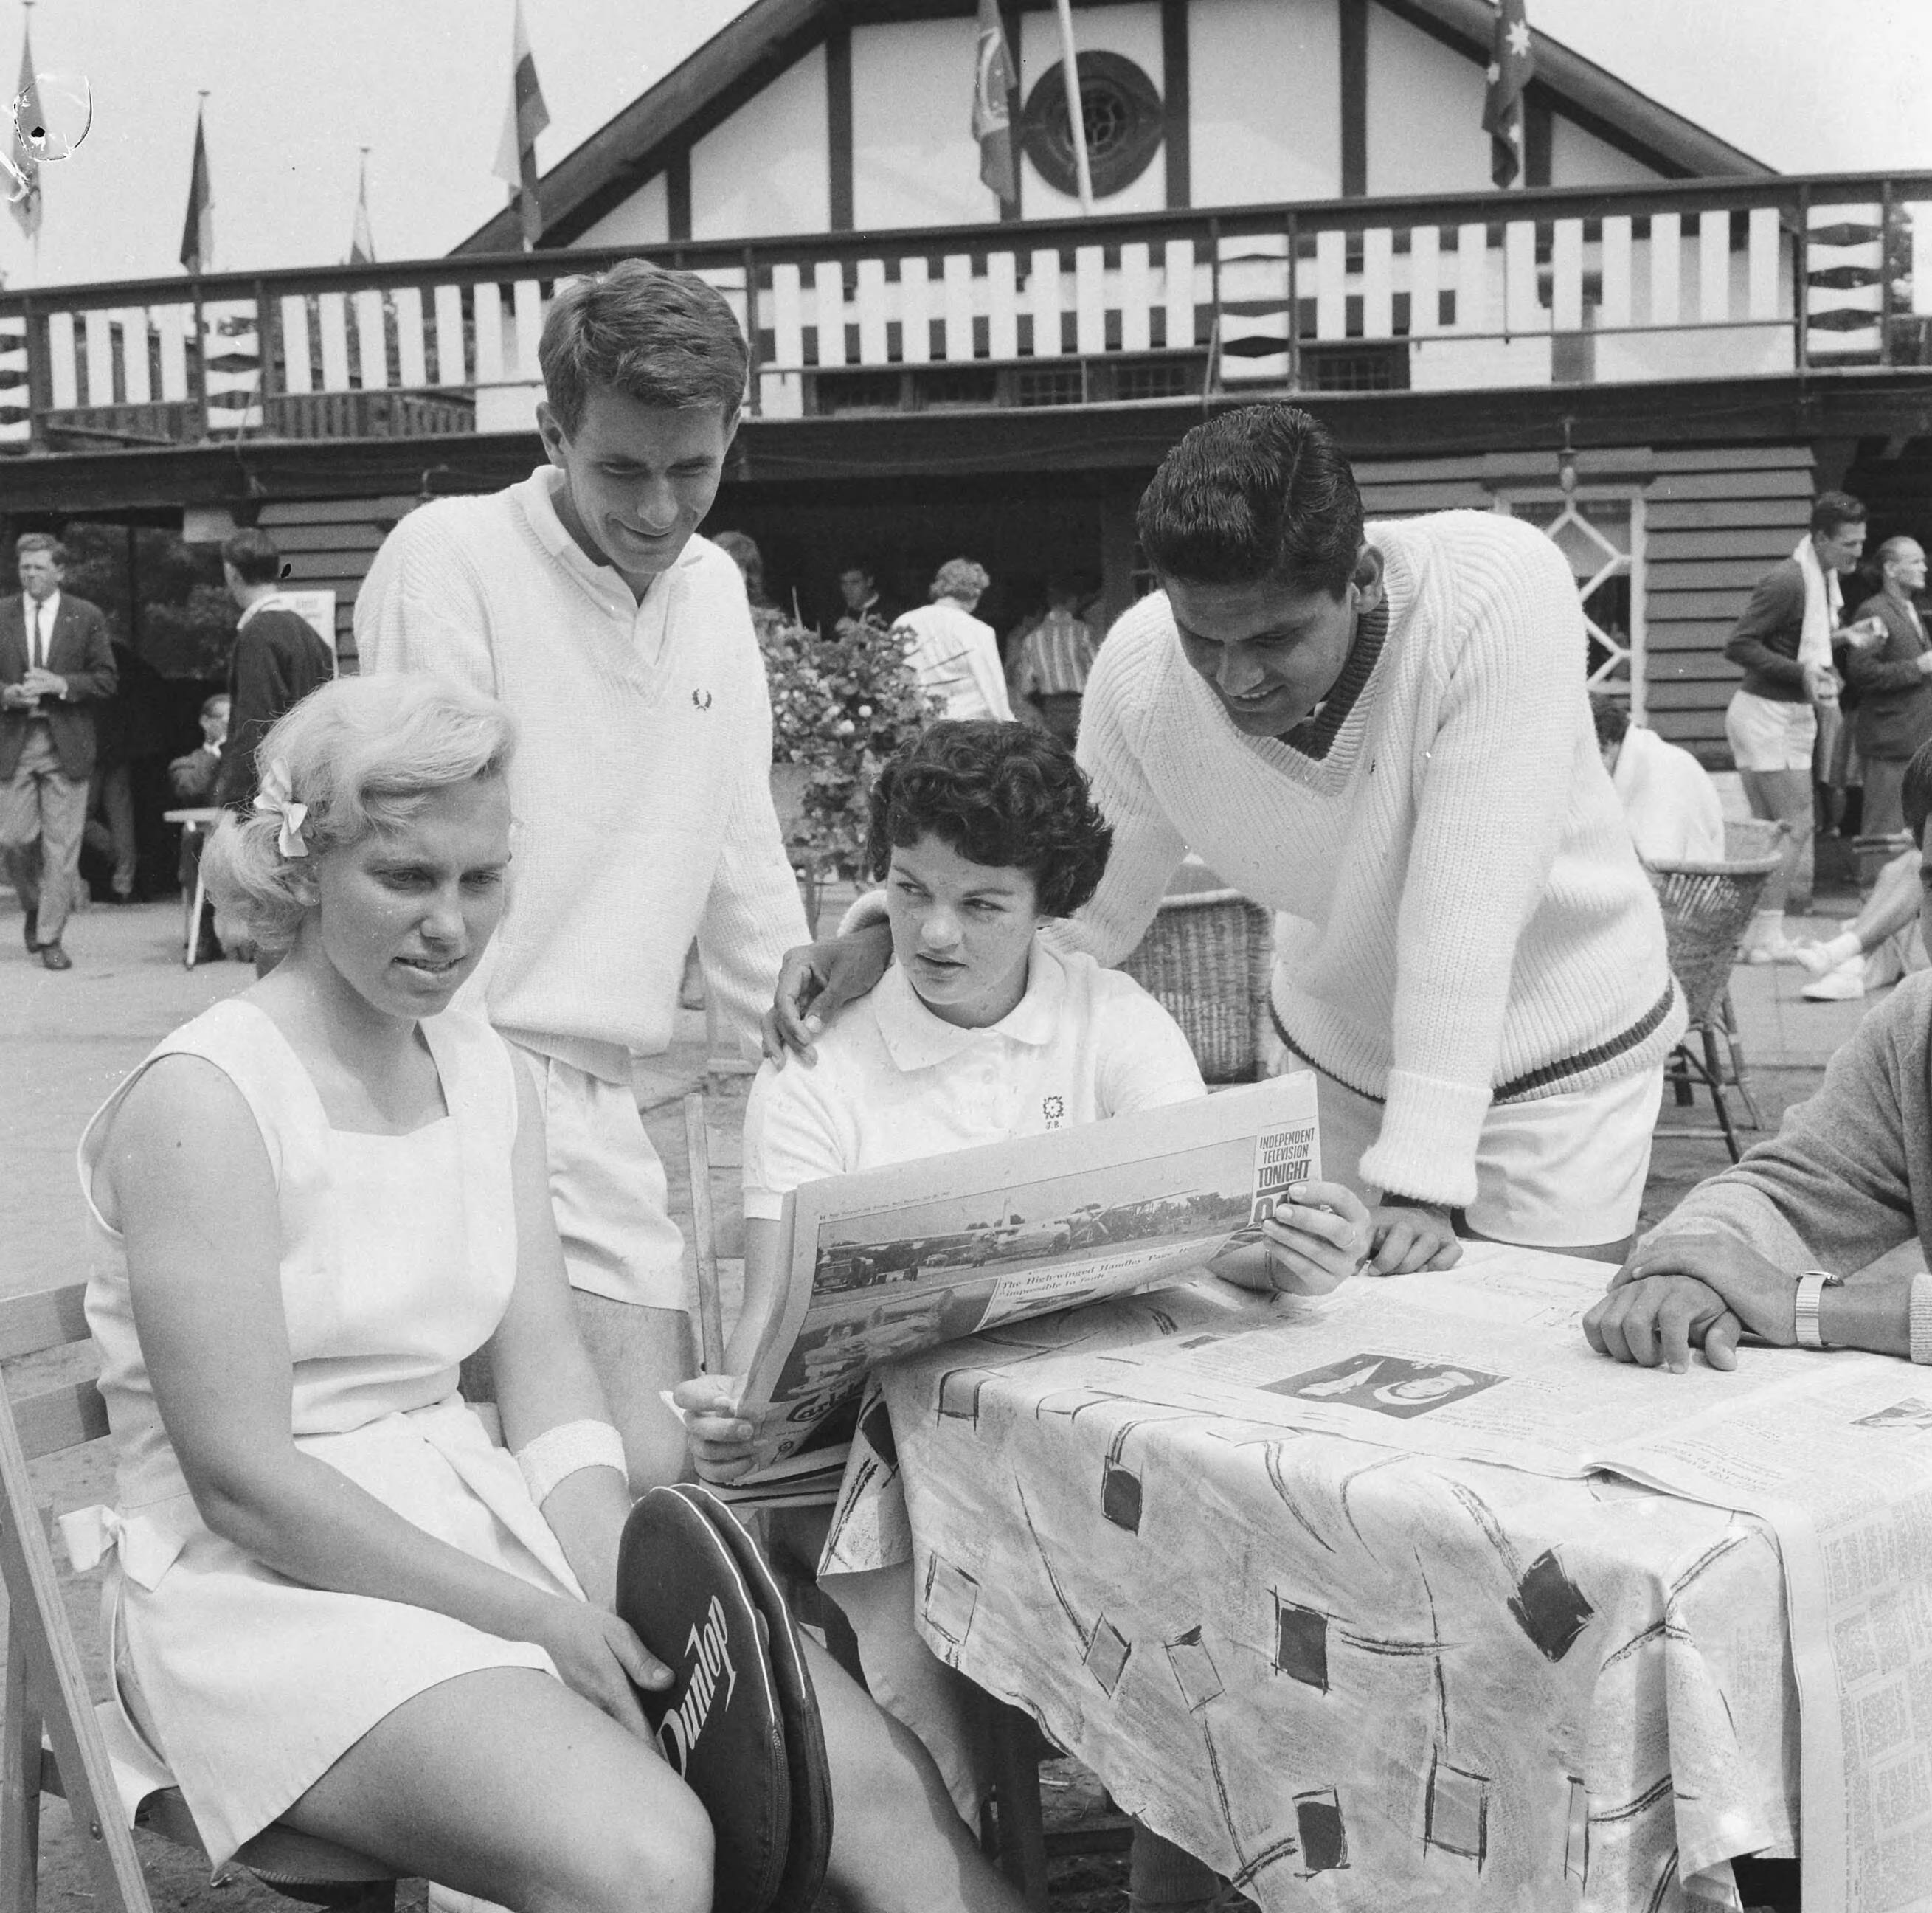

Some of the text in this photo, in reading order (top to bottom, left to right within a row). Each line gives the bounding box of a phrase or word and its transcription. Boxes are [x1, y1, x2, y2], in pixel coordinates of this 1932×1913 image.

[1259, 1127, 1315, 1149] INDEPENDENT
[1263, 1144, 1309, 1164] TELEVISION
[1258, 1159, 1312, 1188] TONIGHT
[1003, 1281, 1022, 1289] The
[1026, 1267, 1095, 1284] High-winged
[656, 1595, 736, 1780] Dunlop
